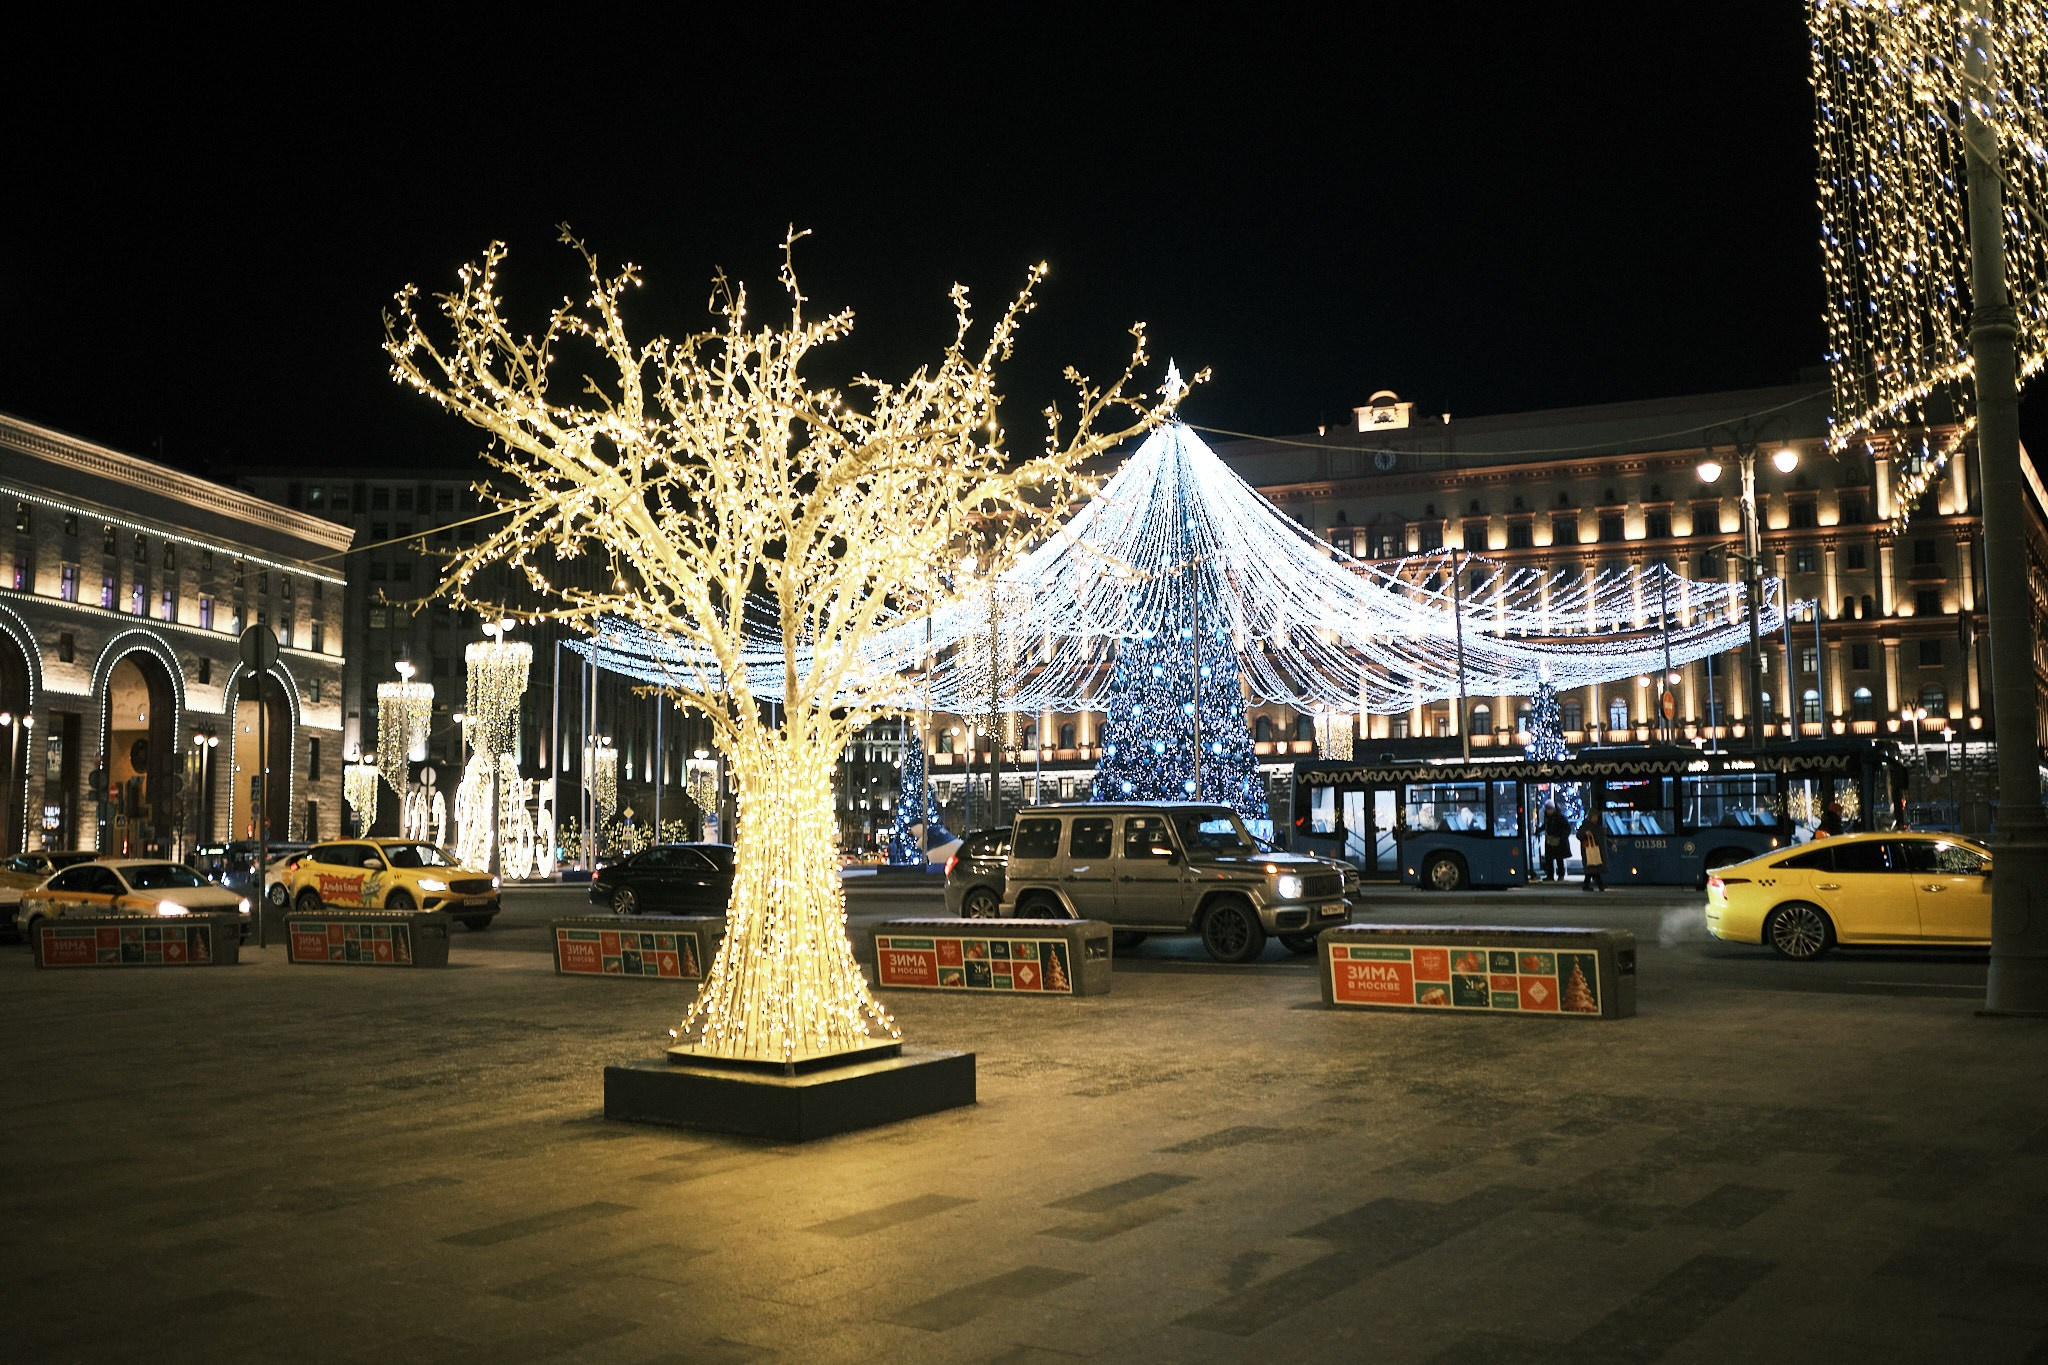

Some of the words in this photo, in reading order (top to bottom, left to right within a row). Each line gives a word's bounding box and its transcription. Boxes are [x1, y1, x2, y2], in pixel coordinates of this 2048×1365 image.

[1634, 840, 1667, 848] 011381
[52, 941, 87, 950] ЗИМА
[566, 944, 595, 956] ЗИМА
[889, 953, 927, 967] ЗИМА
[897, 967, 929, 976] МОСКВЕ
[1347, 965, 1400, 981] ЗИМА
[1358, 981, 1401, 991] МОСКВЕ
